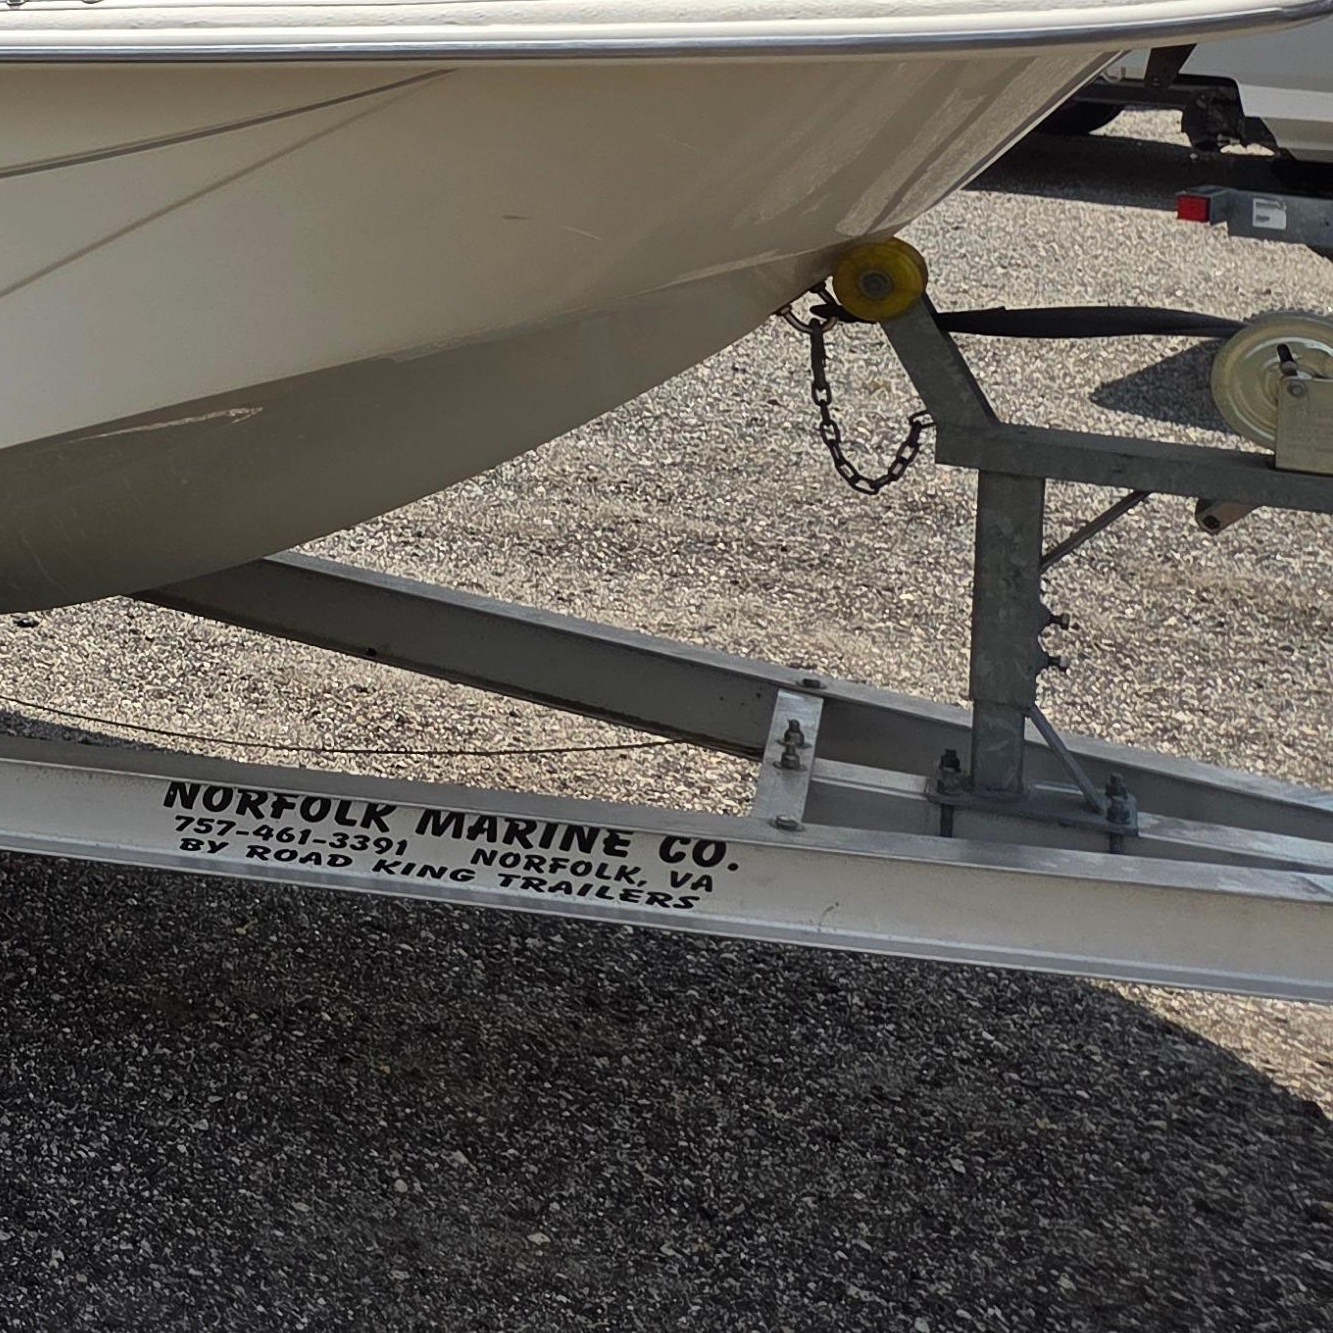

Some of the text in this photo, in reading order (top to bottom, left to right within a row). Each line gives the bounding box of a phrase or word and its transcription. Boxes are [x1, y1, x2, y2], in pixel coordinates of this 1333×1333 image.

[163, 781, 740, 872] NORFOLK MARINE CO.
[173, 814, 715, 894] 757-461-3391 NORFOLK, VA
[178, 836, 701, 911] BY ROAD KING TRAILERS
